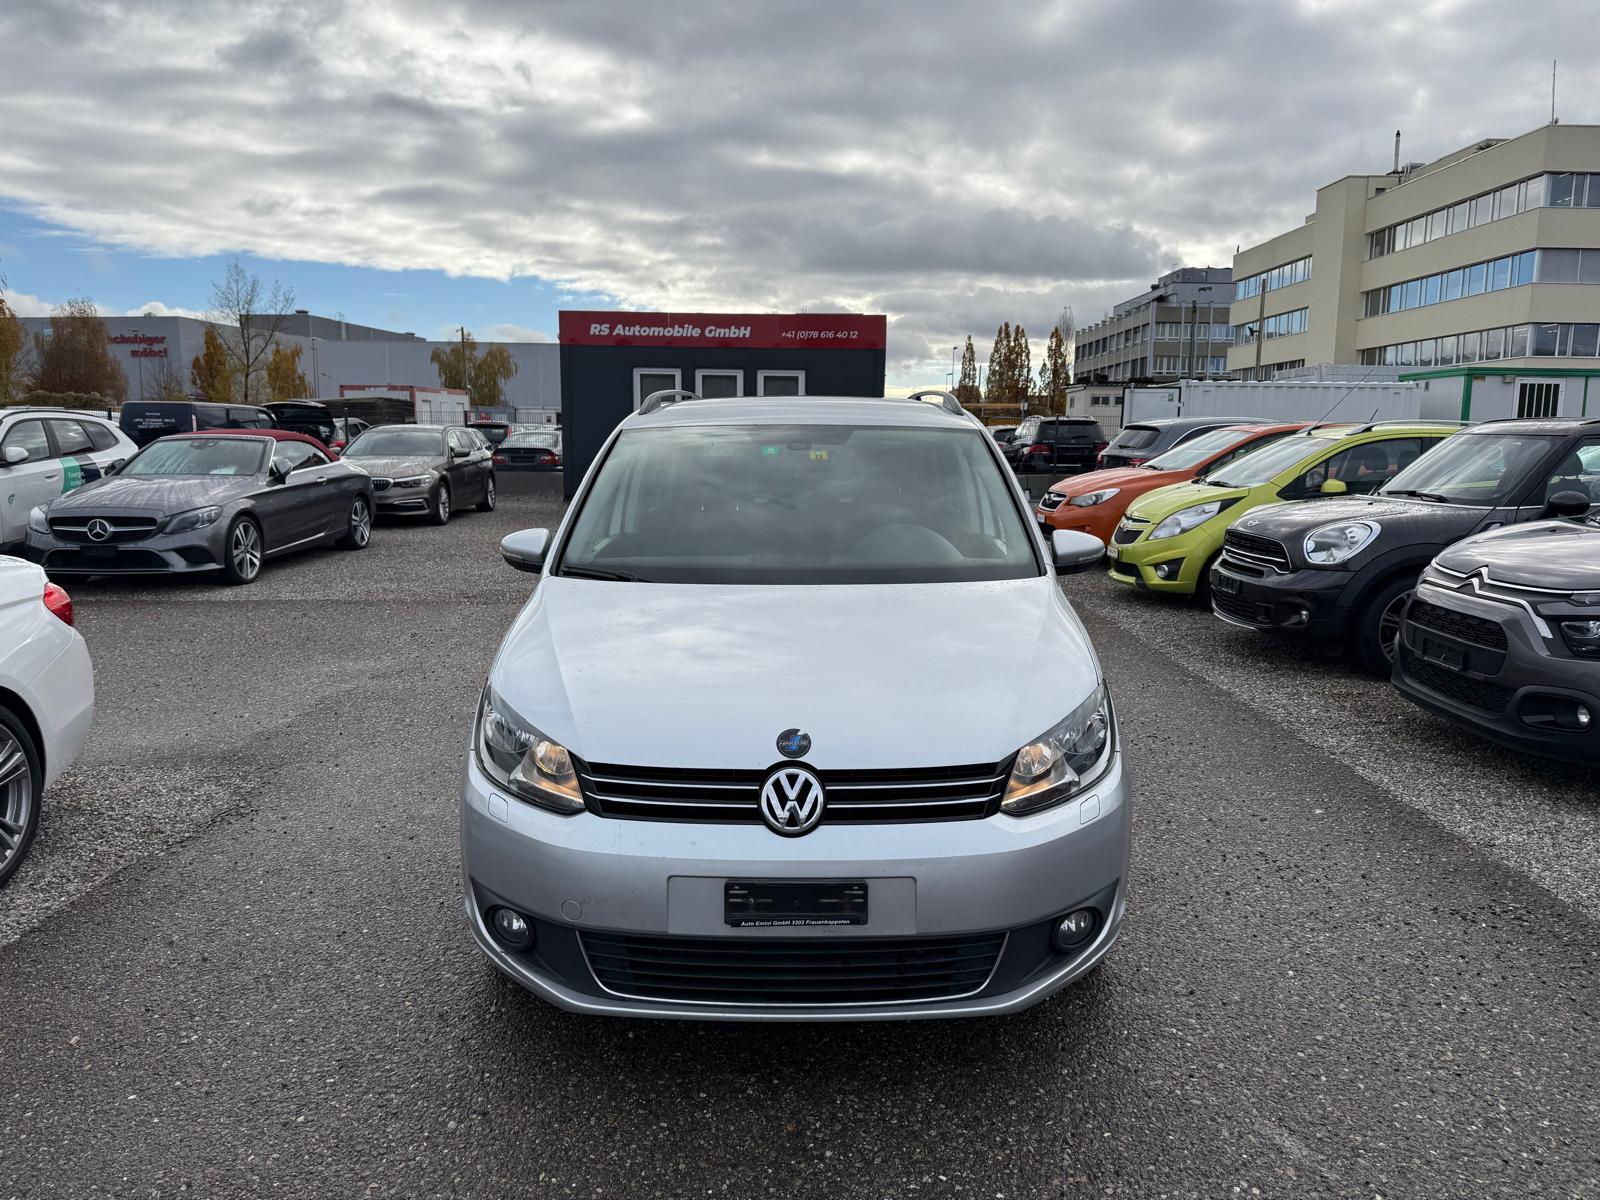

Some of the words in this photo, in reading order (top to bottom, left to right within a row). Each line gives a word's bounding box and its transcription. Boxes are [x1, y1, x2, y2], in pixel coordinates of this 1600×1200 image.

[589, 323, 610, 336] RS
[613, 324, 702, 337] Automobile
[704, 325, 751, 338] GmbH
[781, 330, 796, 339] +41
[796, 330, 819, 340] (0)78
[820, 330, 836, 339] 616
[836, 330, 848, 339] 40
[849, 330, 859, 339] 12
